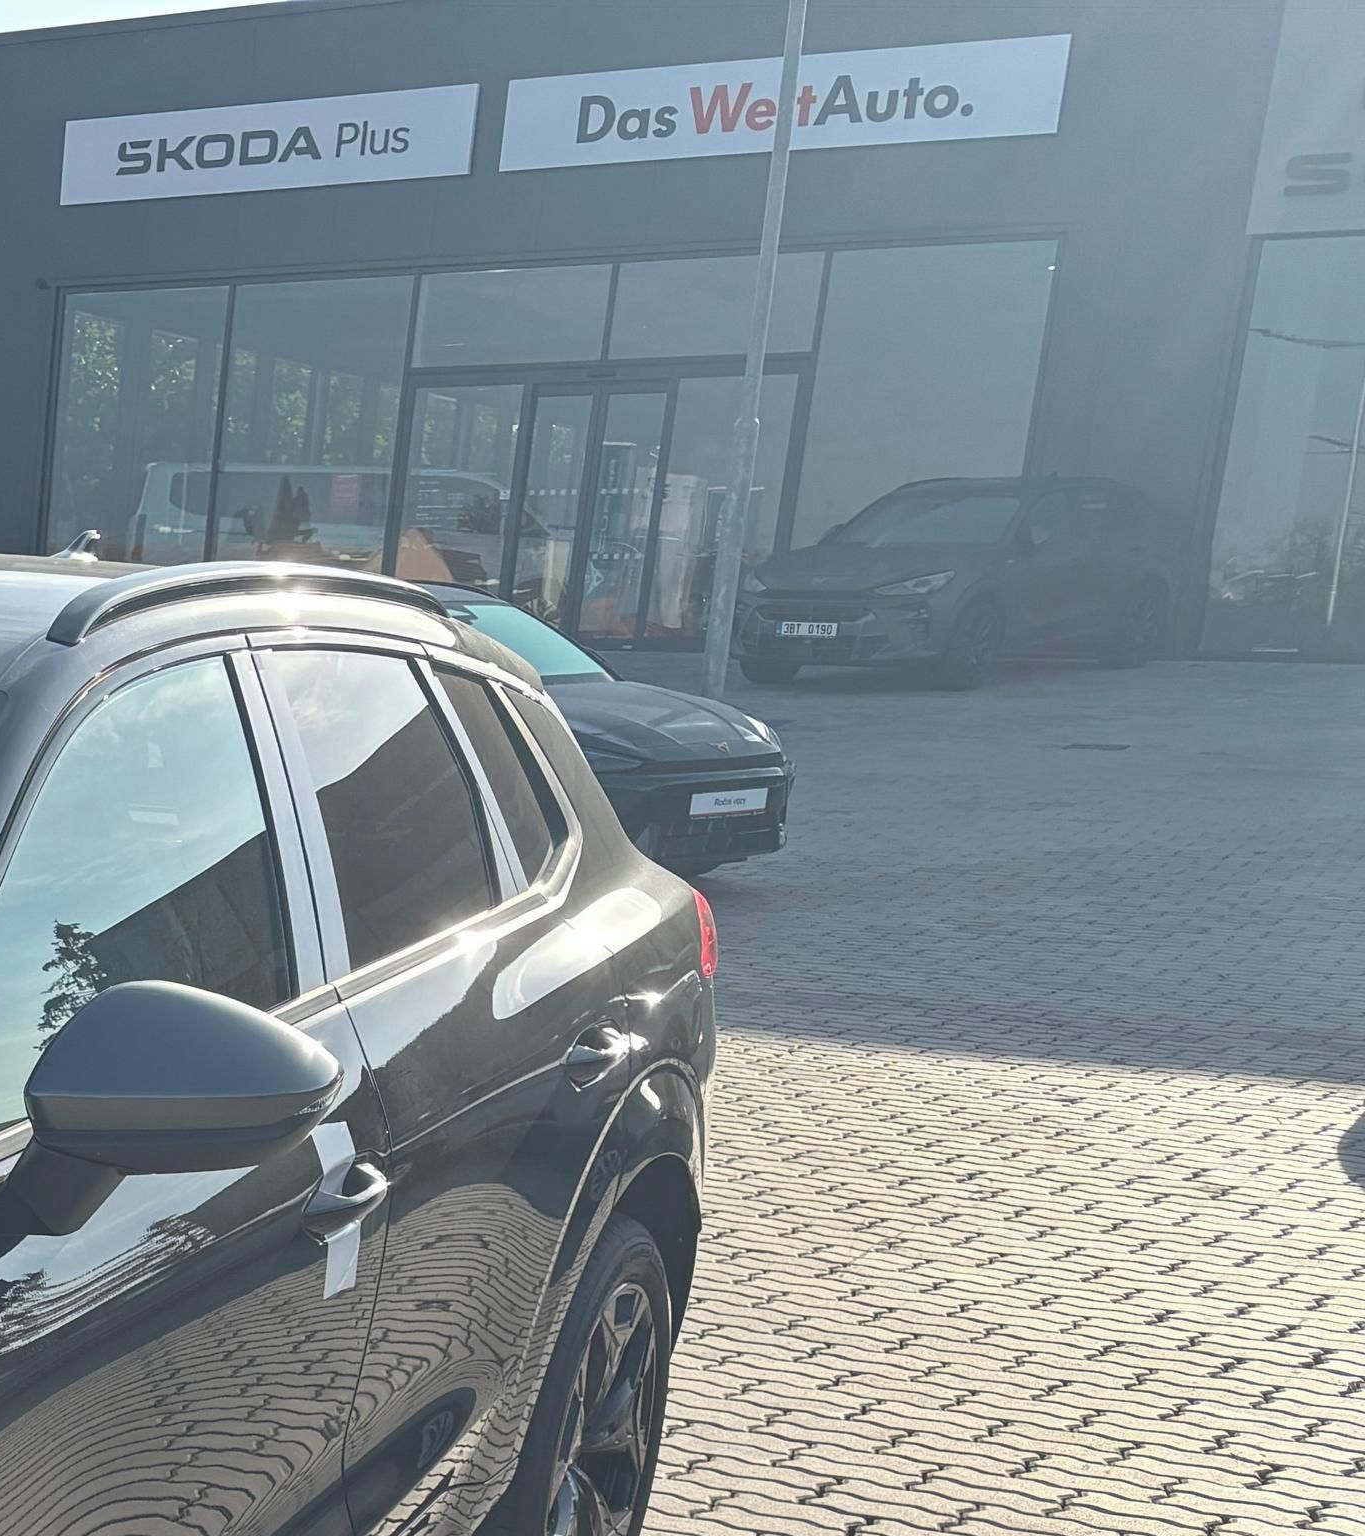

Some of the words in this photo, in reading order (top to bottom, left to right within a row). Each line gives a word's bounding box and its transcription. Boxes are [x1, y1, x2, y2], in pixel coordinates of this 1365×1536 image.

[576, 94, 678, 145] Das
[689, 75, 975, 136] WetAuto.
[335, 120, 411, 158] Plus
[783, 623, 802, 634] 3BT
[808, 624, 833, 635] 0190
